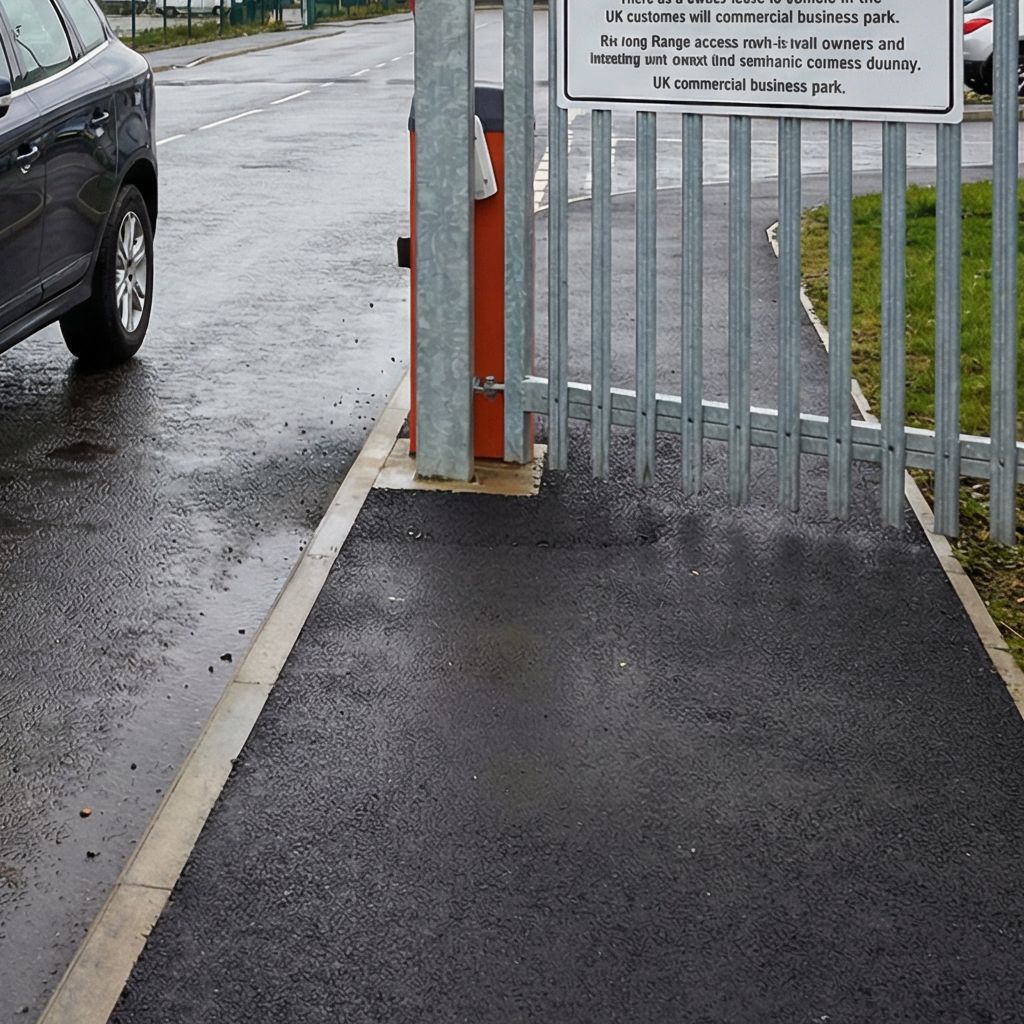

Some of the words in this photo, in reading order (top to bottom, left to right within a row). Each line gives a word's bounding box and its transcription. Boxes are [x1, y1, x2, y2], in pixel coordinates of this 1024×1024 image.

[606, 10, 623, 23] UK
[626, 10, 686, 24] customes
[689, 10, 711, 24] will
[715, 10, 793, 24] commercial
[797, 10, 859, 24] business
[863, 10, 900, 26] park.
[651, 34, 691, 50] Range
[694, 37, 739, 49] access
[822, 38, 874, 50] owners
[878, 37, 905, 50] and
[653, 76, 671, 90] UK
[674, 78, 746, 92] commercial
[750, 78, 808, 92] business
[812, 80, 846, 96] park.
